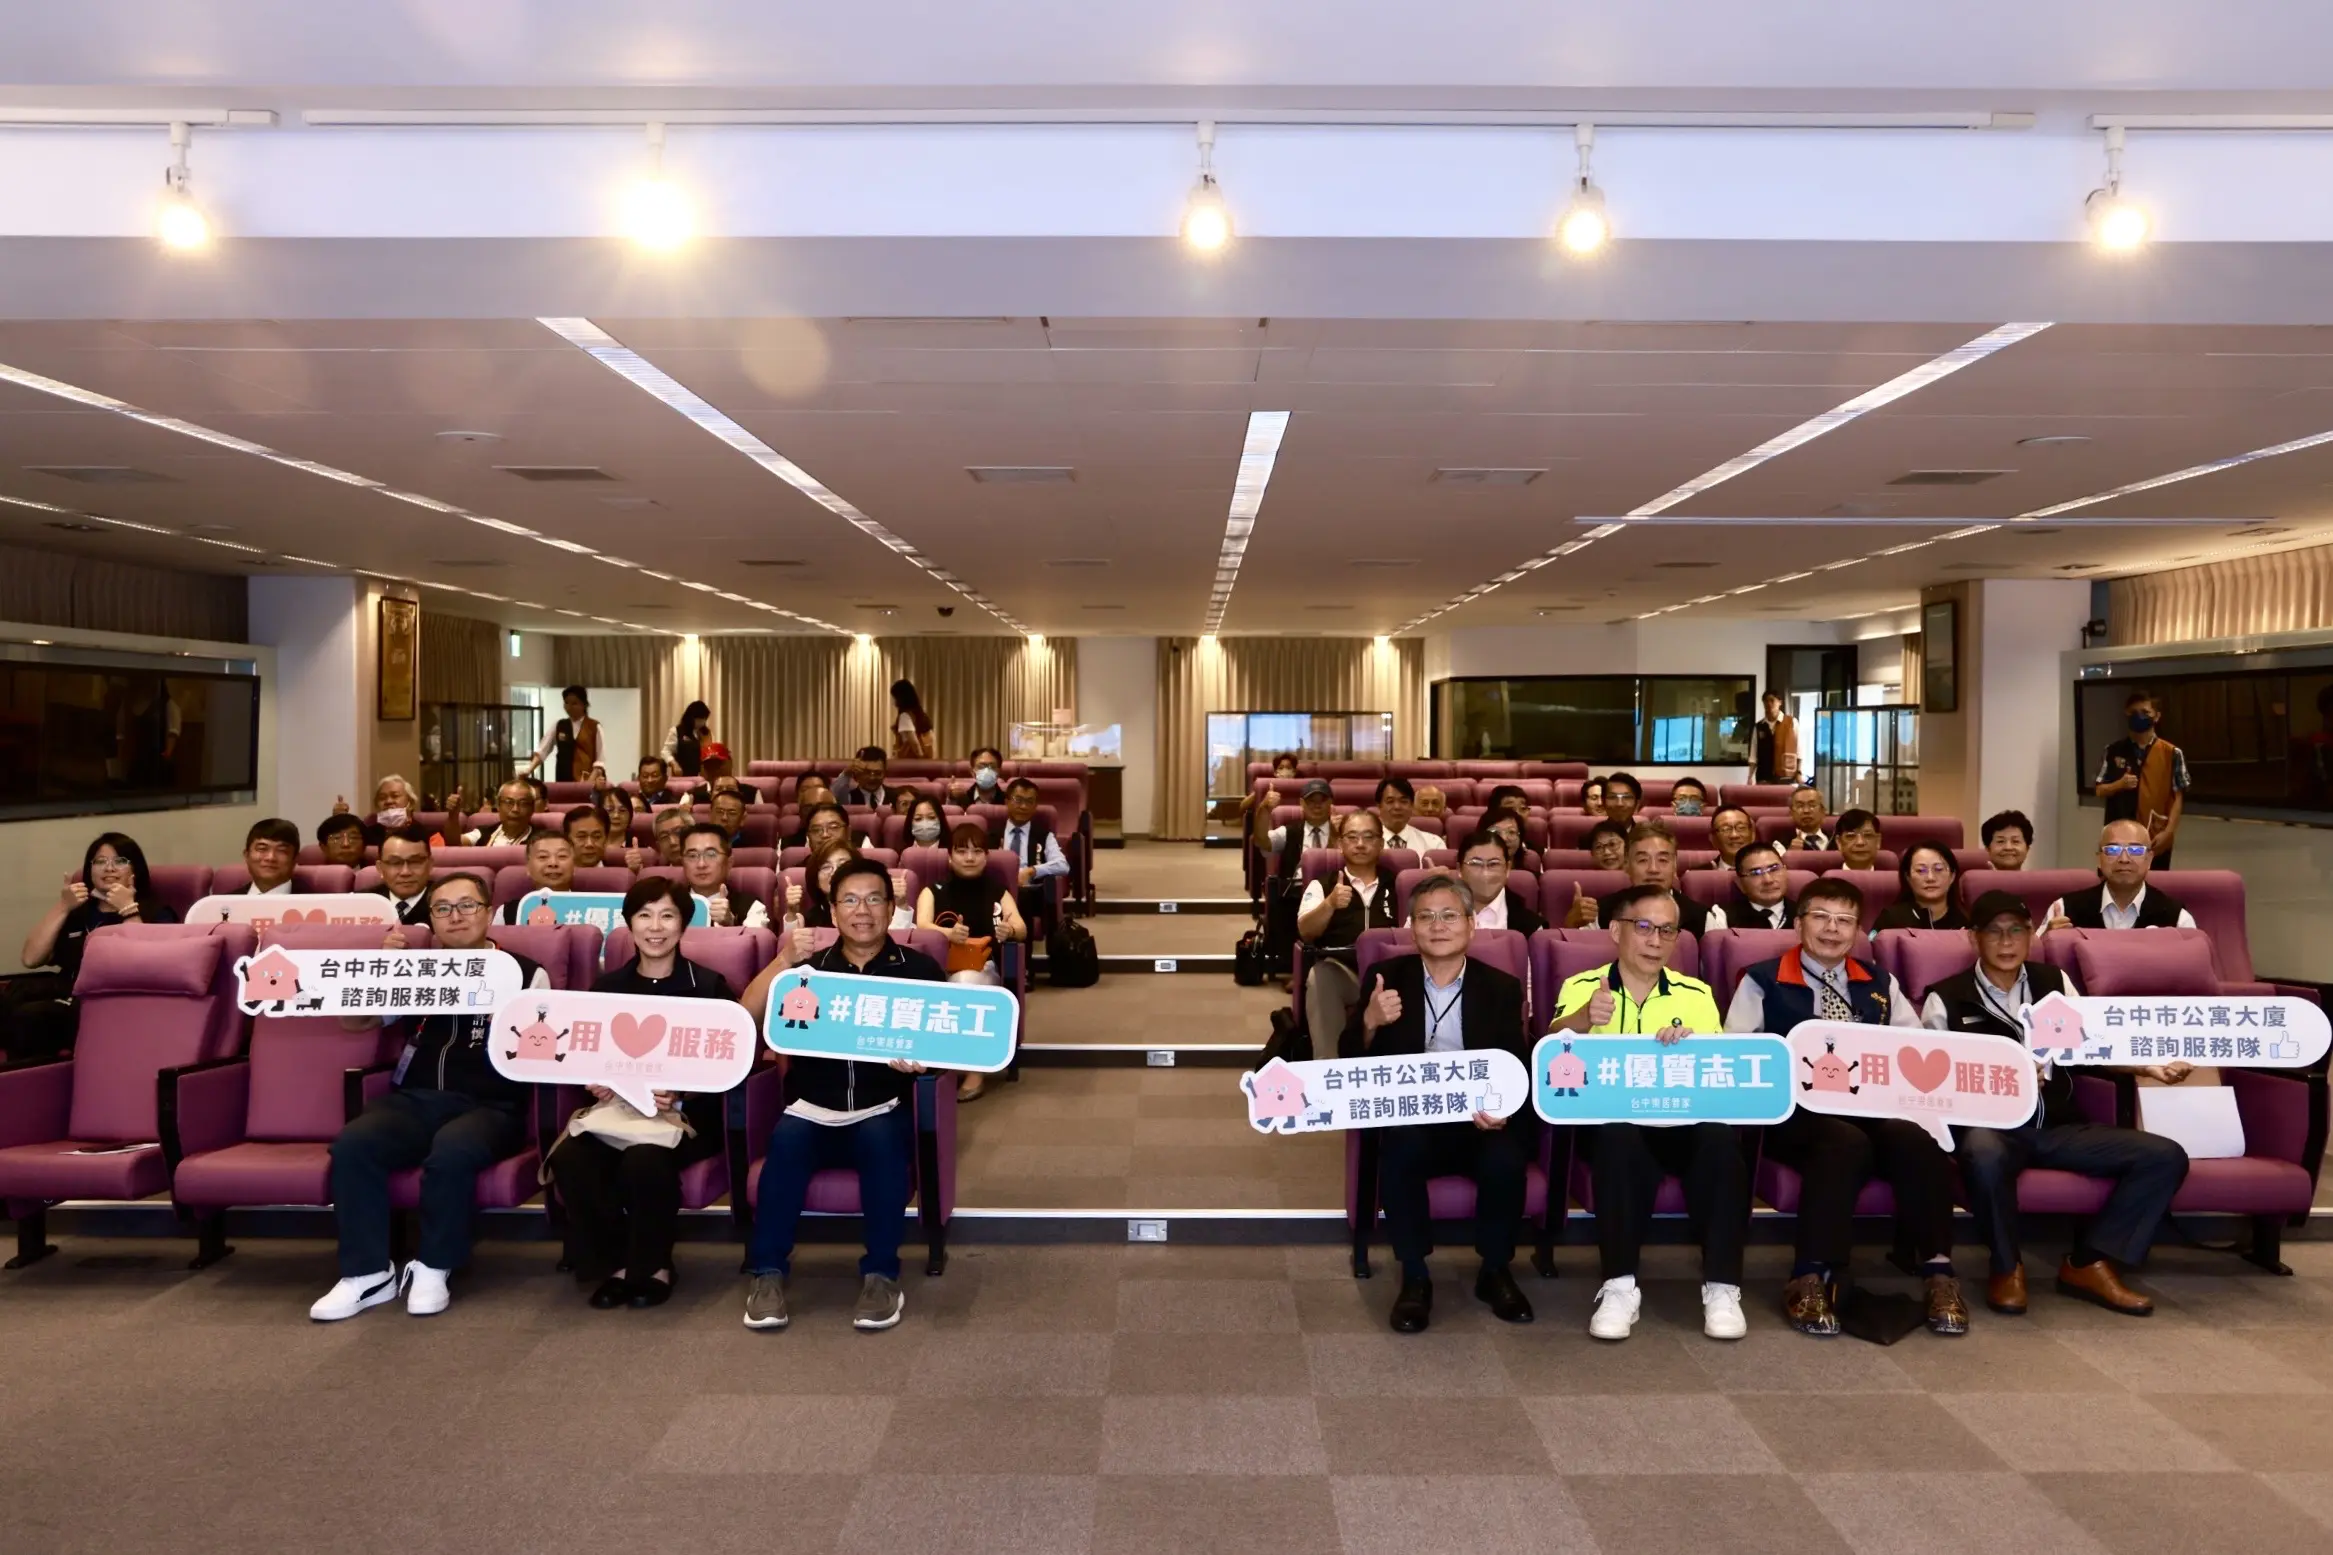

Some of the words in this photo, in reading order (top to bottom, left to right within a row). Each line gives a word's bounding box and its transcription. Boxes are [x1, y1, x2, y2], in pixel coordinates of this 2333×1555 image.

[320, 957, 487, 979] 台中市公寓大廈
[341, 986, 461, 1008] 諮詢服務隊
[828, 993, 997, 1038] #優質志工
[2104, 1005, 2287, 1028] 台中市公寓大廈
[2130, 1035, 2262, 1059] 諮詢服務隊
[1323, 1058, 1491, 1091] 台中市公寓大廈
[1597, 1053, 1774, 1089] #優質志工
[1349, 1091, 1469, 1121] 諮詢服務隊
